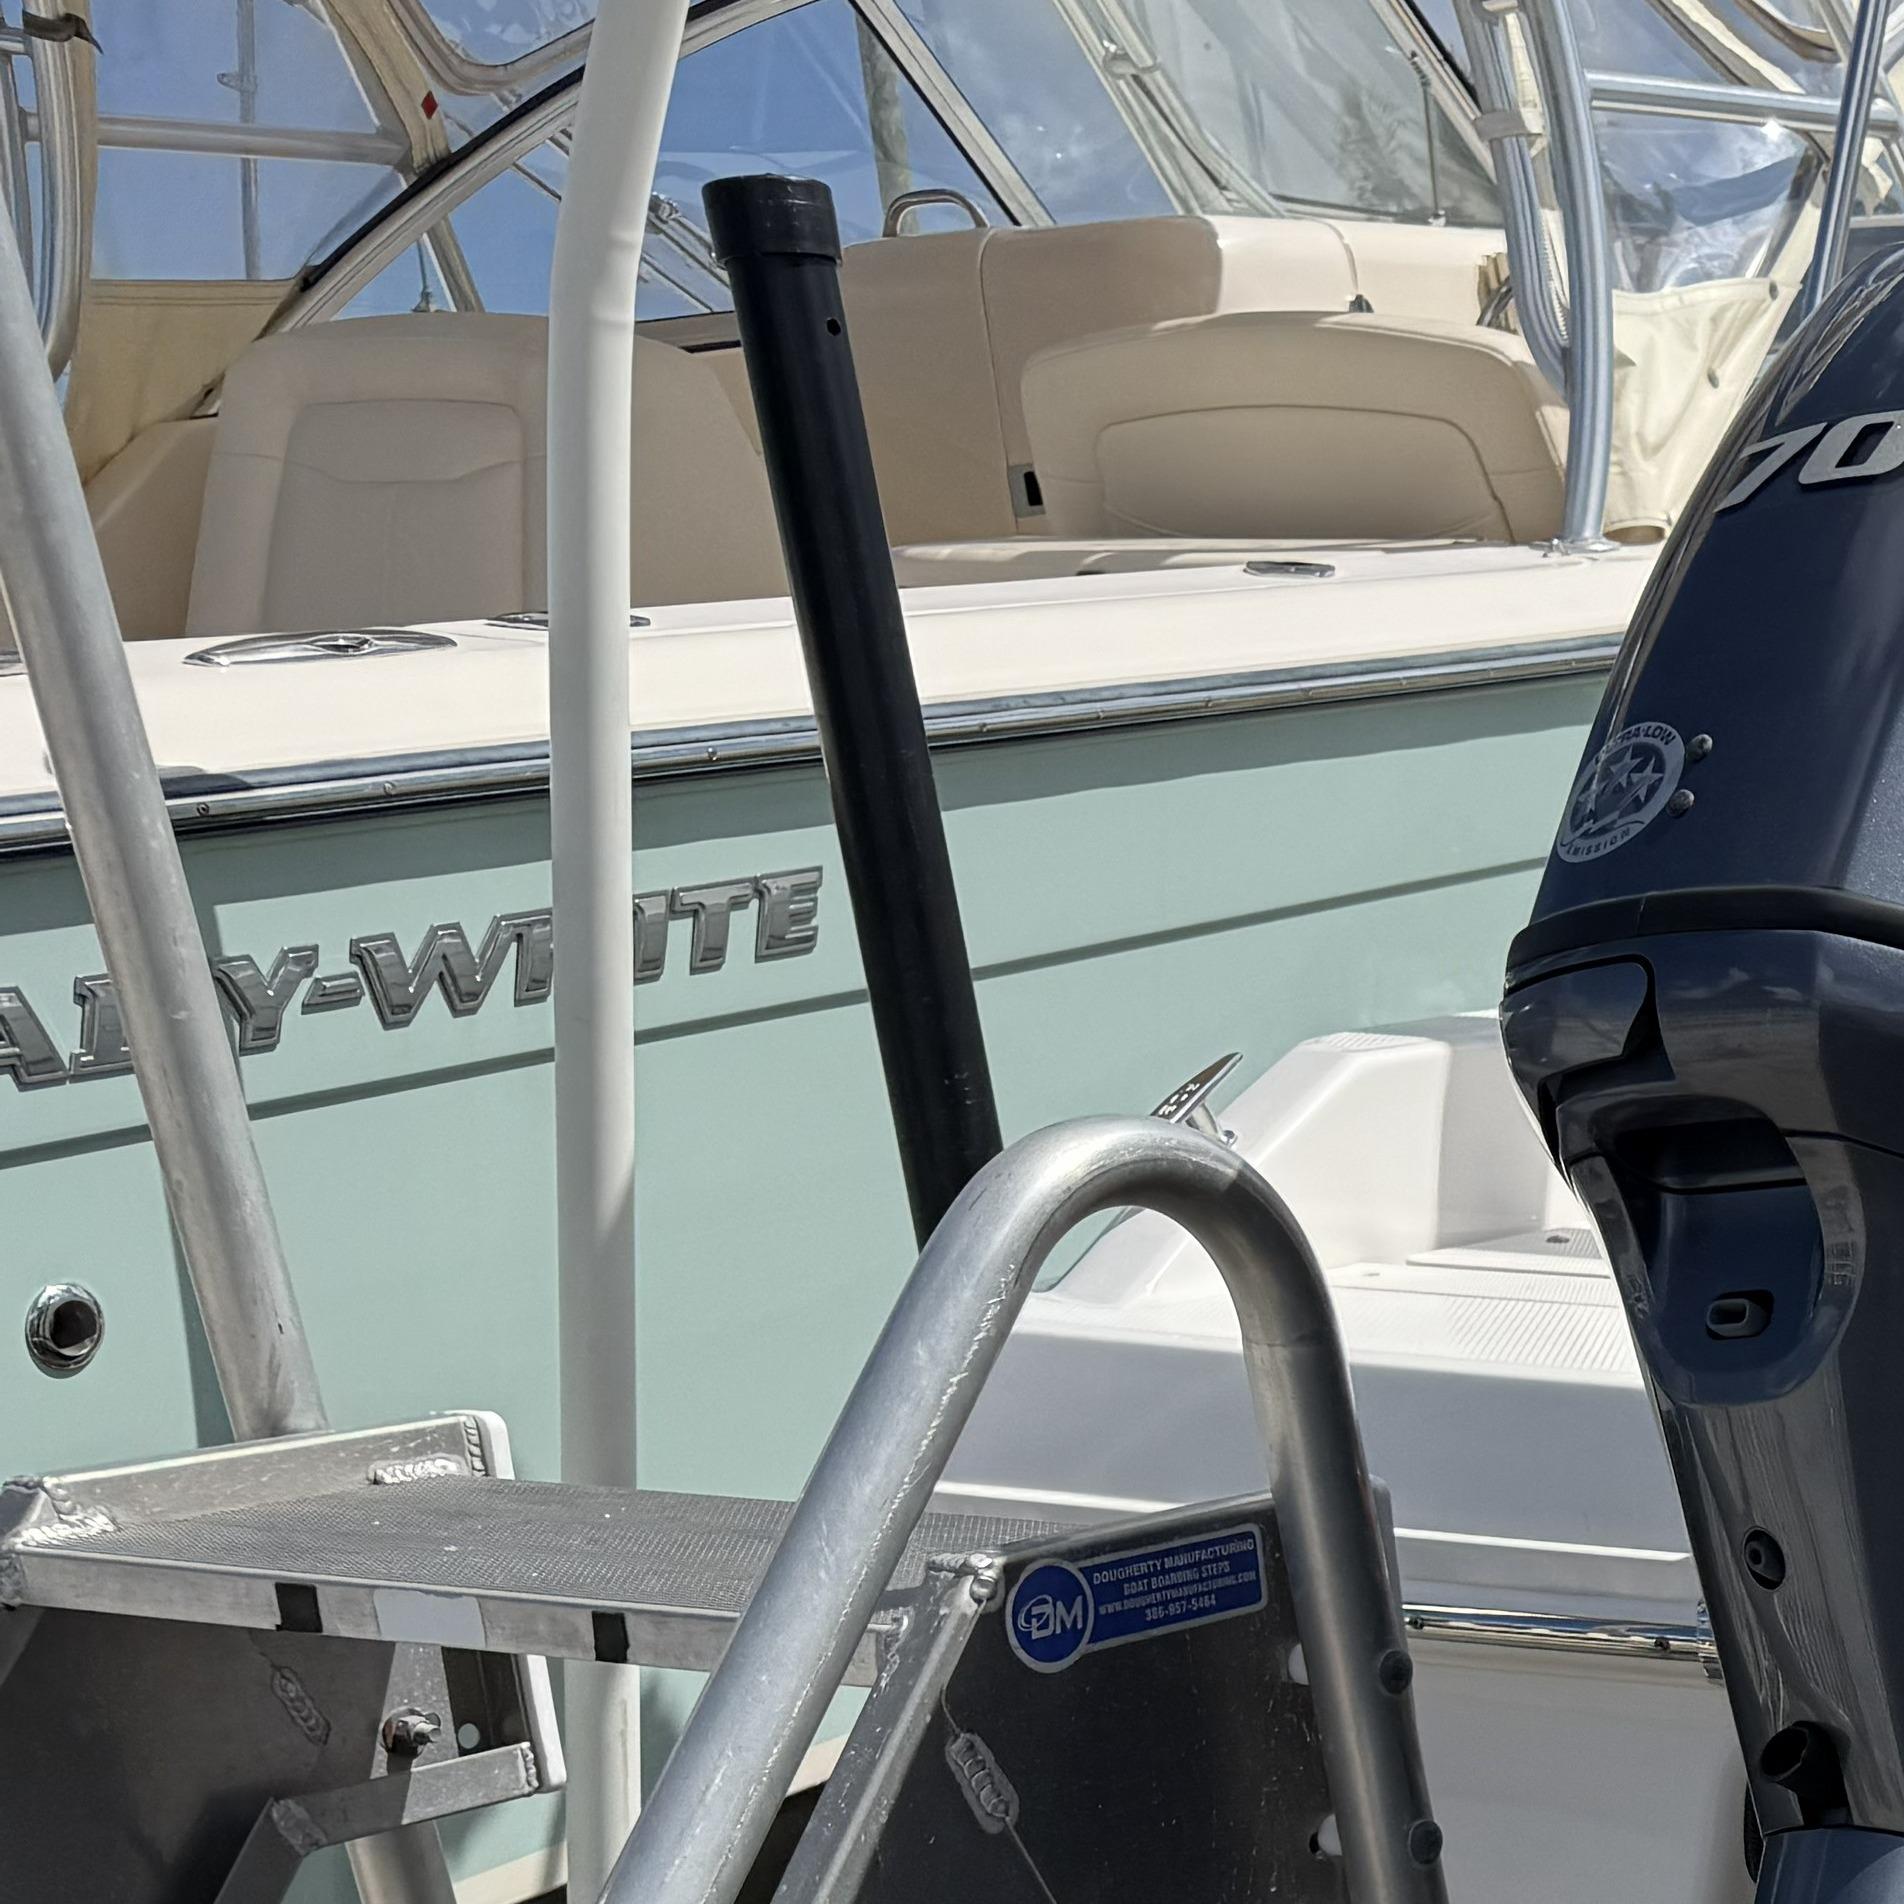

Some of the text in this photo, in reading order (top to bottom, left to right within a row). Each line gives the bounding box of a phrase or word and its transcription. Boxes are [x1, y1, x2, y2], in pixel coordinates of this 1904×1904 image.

[1092, 1538, 1254, 1585] DOUGHERTY MANUFACTURING
[1123, 1560, 1231, 1596] BOAT BOARDING STEPS
